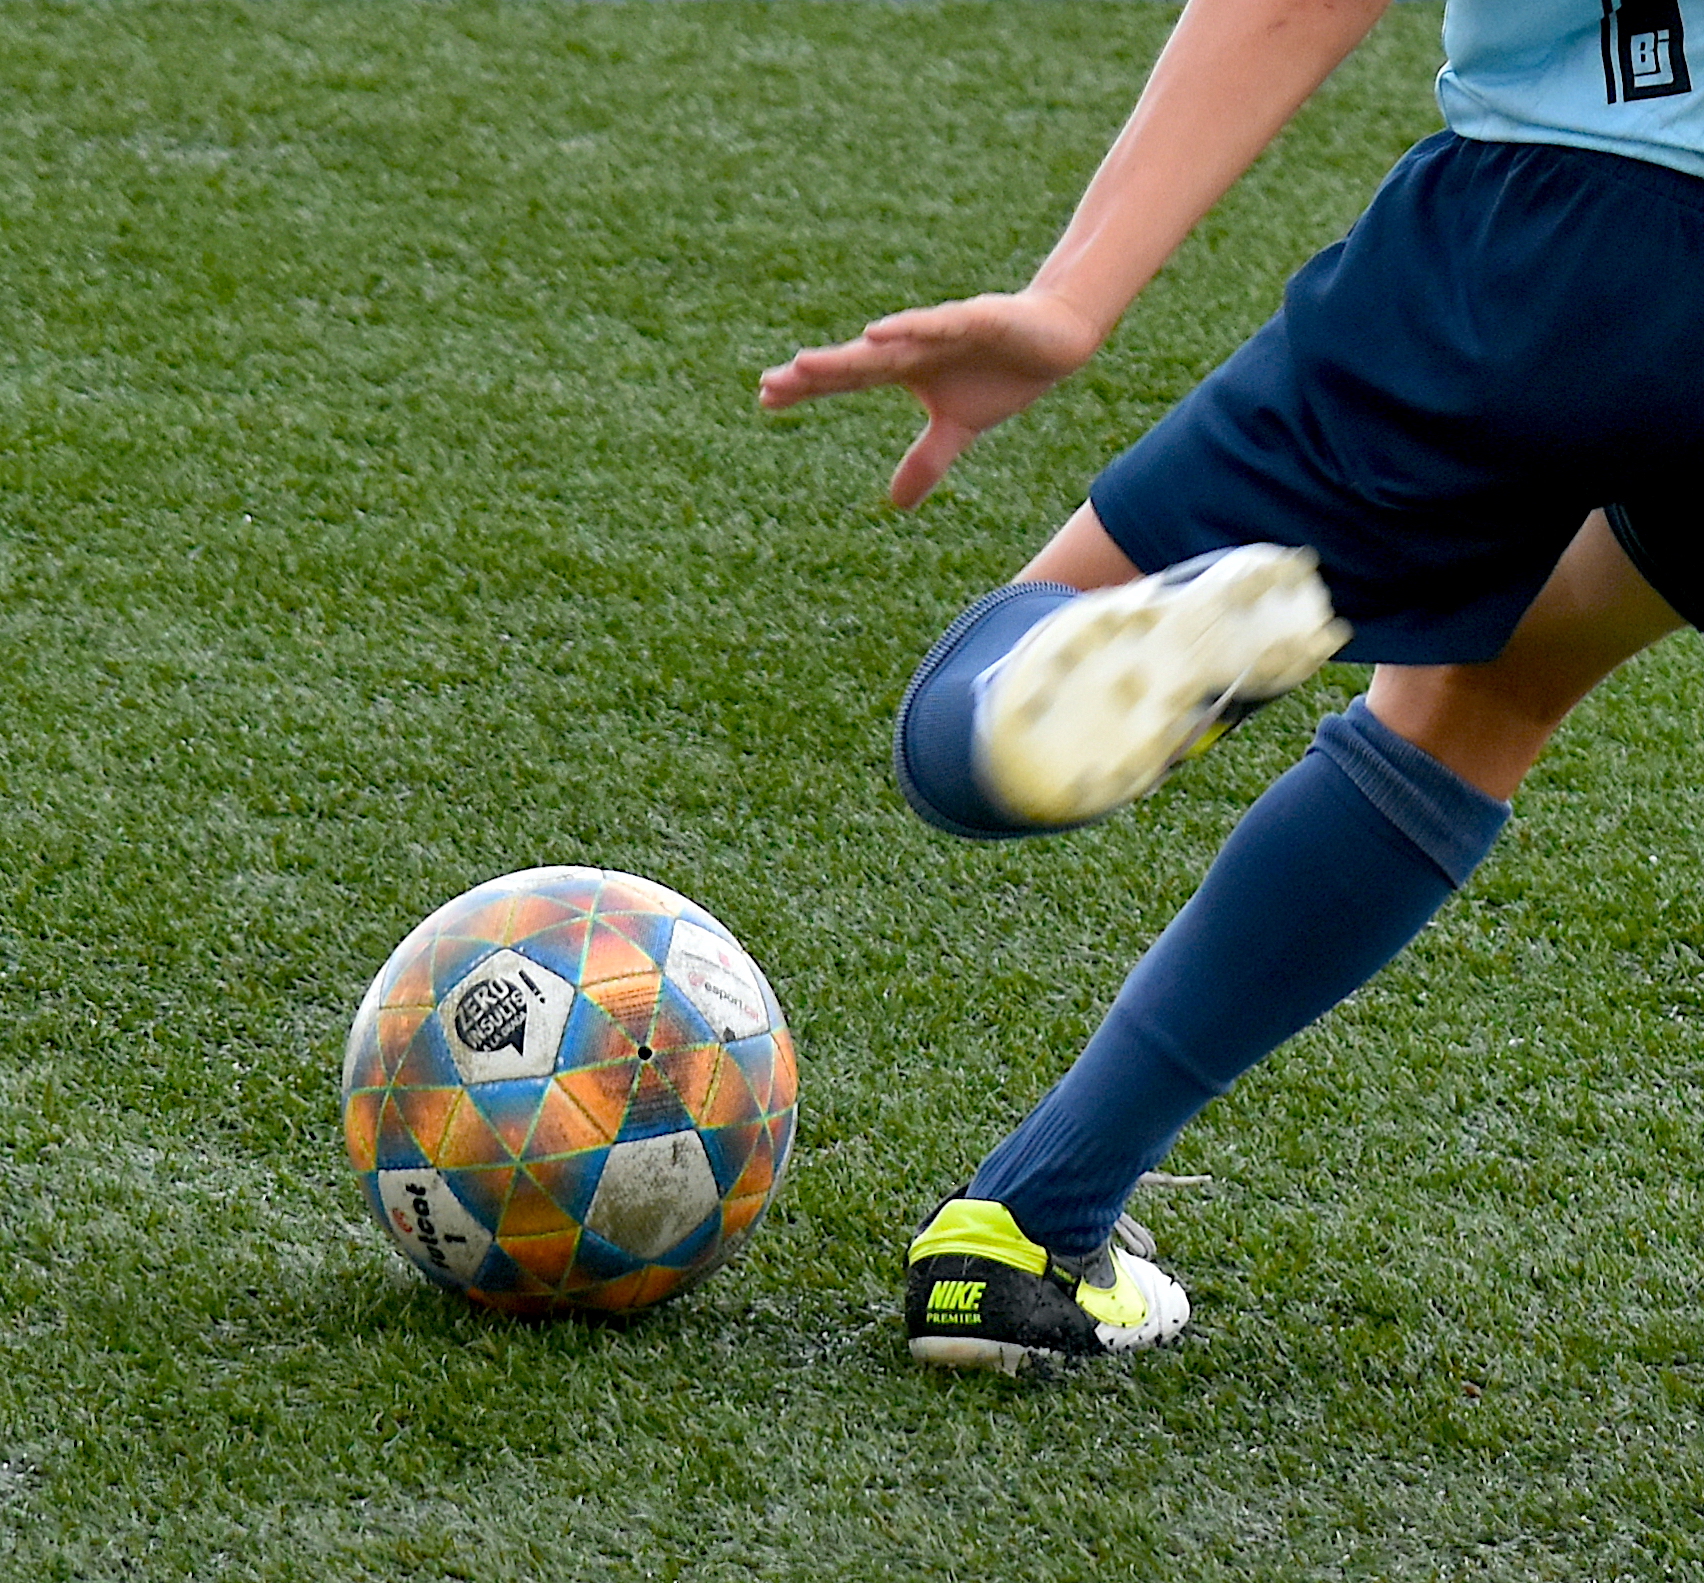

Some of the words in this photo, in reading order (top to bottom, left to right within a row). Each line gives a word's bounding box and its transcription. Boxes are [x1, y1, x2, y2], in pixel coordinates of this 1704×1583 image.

[458, 977, 510, 1032] ZERO
[466, 990, 526, 1049] INSULTS
[927, 1280, 987, 1311] NIKE
[926, 1312, 983, 1324] PREMIER
